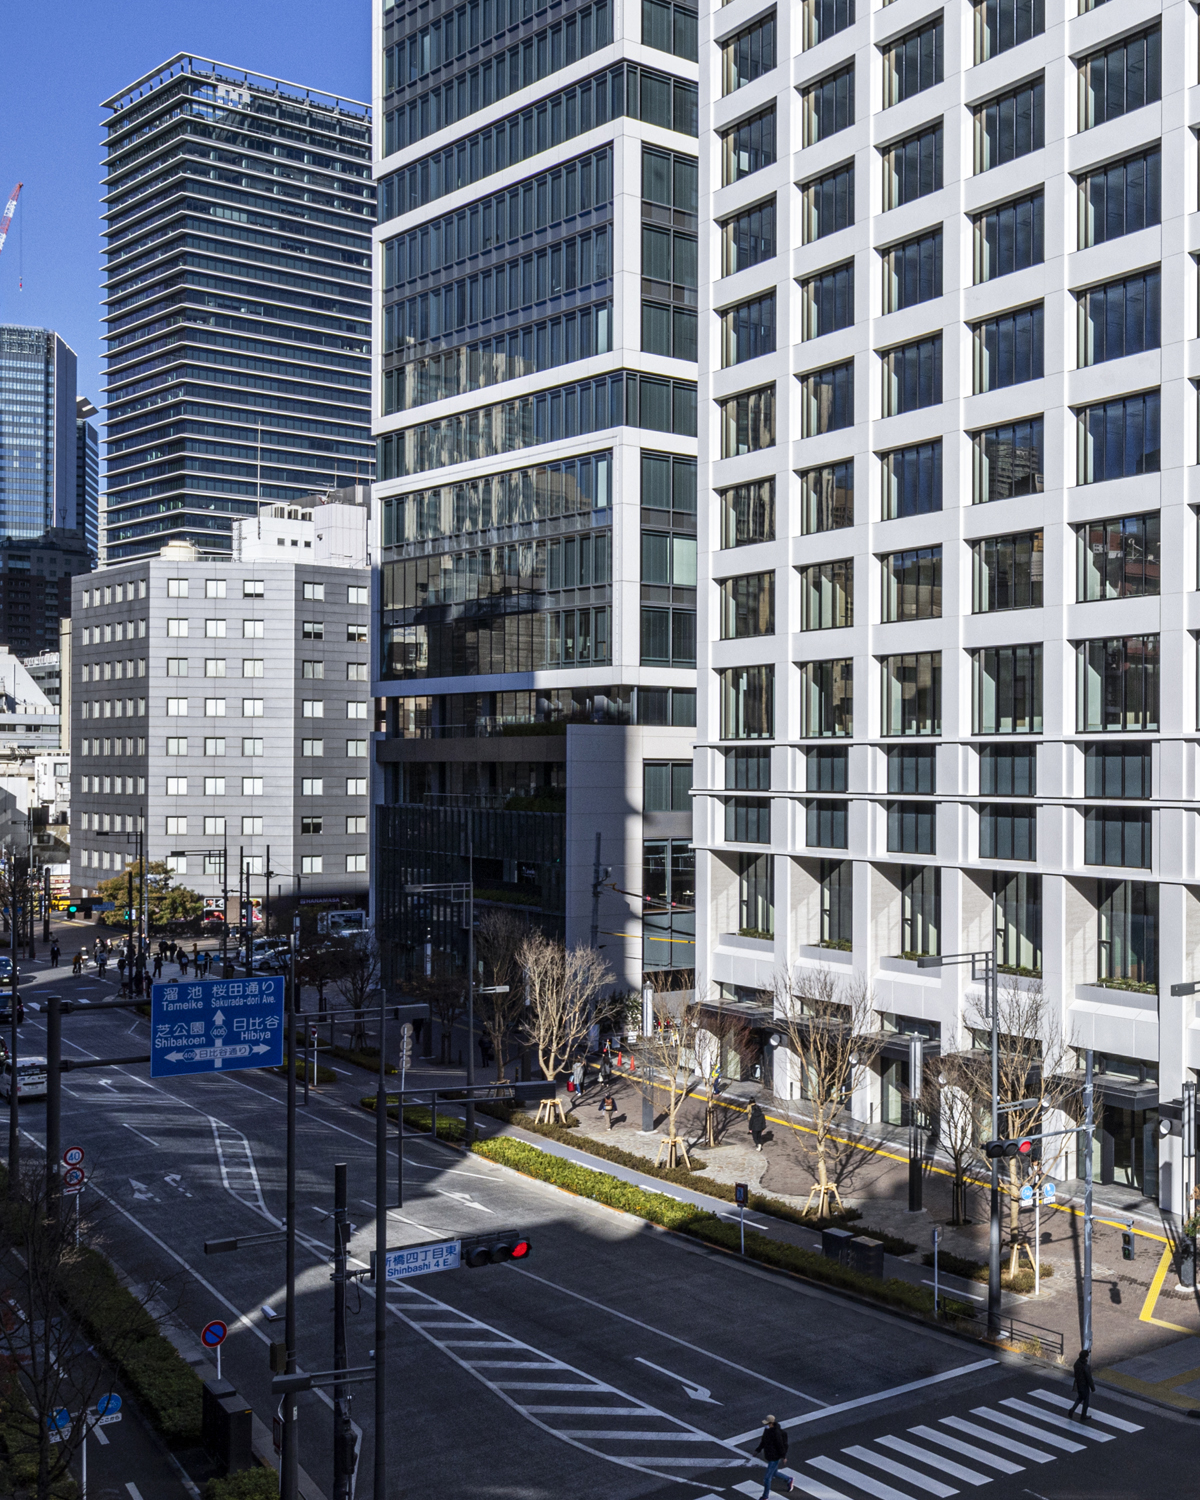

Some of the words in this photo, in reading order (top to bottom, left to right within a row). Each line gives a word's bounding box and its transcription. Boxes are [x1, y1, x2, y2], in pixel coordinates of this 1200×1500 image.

[212, 981, 275, 997] 桜田通り
[162, 1000, 203, 1011] Tameike
[211, 995, 260, 1008] Sakurada-dori
[262, 994, 276, 1004] Ave.
[156, 1021, 205, 1038] 芝公園
[233, 1015, 280, 1032] 日比谷
[212, 1028, 226, 1036] 405
[240, 1030, 271, 1042] Hibiya
[155, 1036, 206, 1048] Shibakoen
[199, 1047, 247, 1059] 日比谷通り
[68, 1152, 81, 1161] 40
[387, 1261, 431, 1277] Shinbashi
[434, 1259, 440, 1268] 4
[443, 1258, 452, 1267] E.
